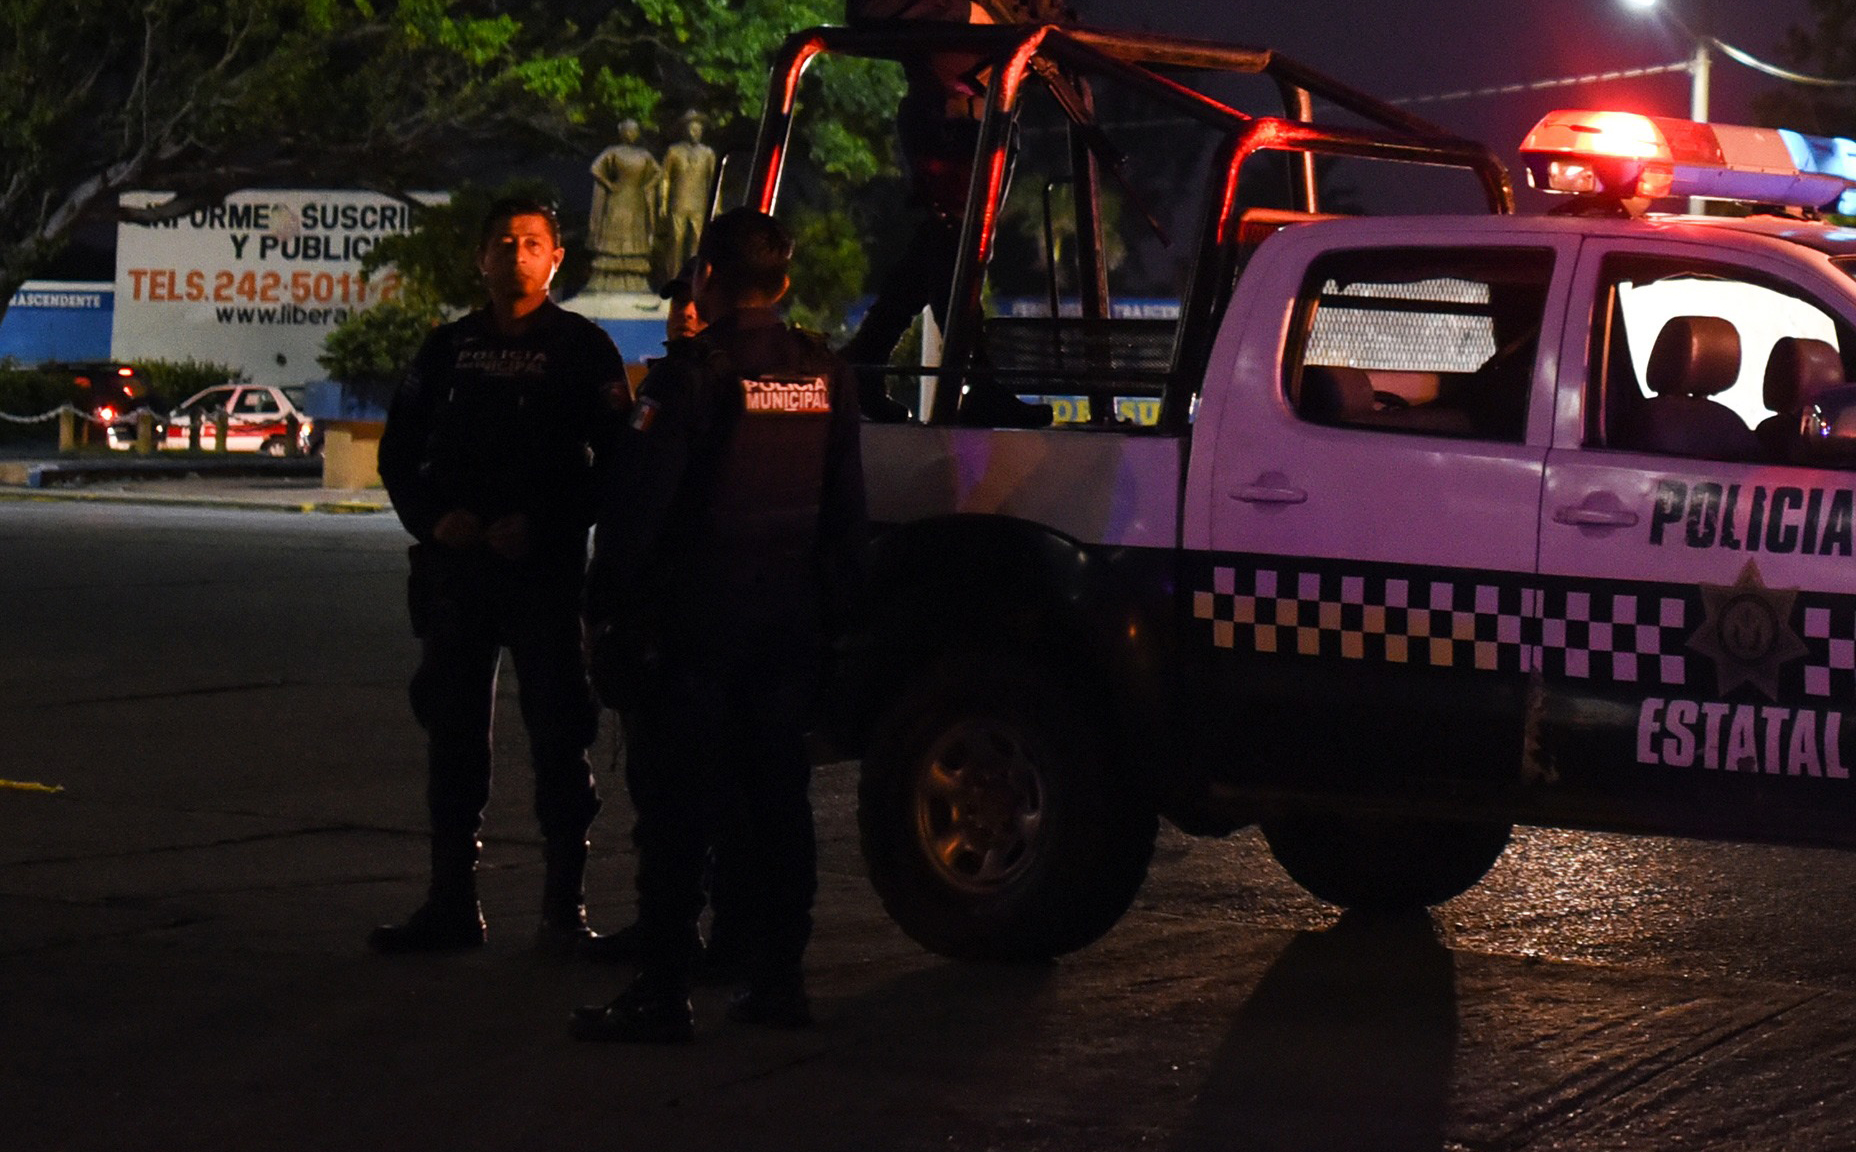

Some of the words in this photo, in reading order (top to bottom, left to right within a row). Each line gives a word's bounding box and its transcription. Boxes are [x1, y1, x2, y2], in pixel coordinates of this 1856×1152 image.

[301, 203, 412, 230] SUSCRI
[229, 234, 249, 261] Y
[260, 234, 380, 261] PUBLIC
[128, 268, 208, 303] TELS.
[215, 303, 354, 326] www.libera
[746, 391, 830, 410] MUNICIPAL
[1649, 479, 1854, 557] POLICIA
[1636, 697, 1850, 780] ESTATAL
